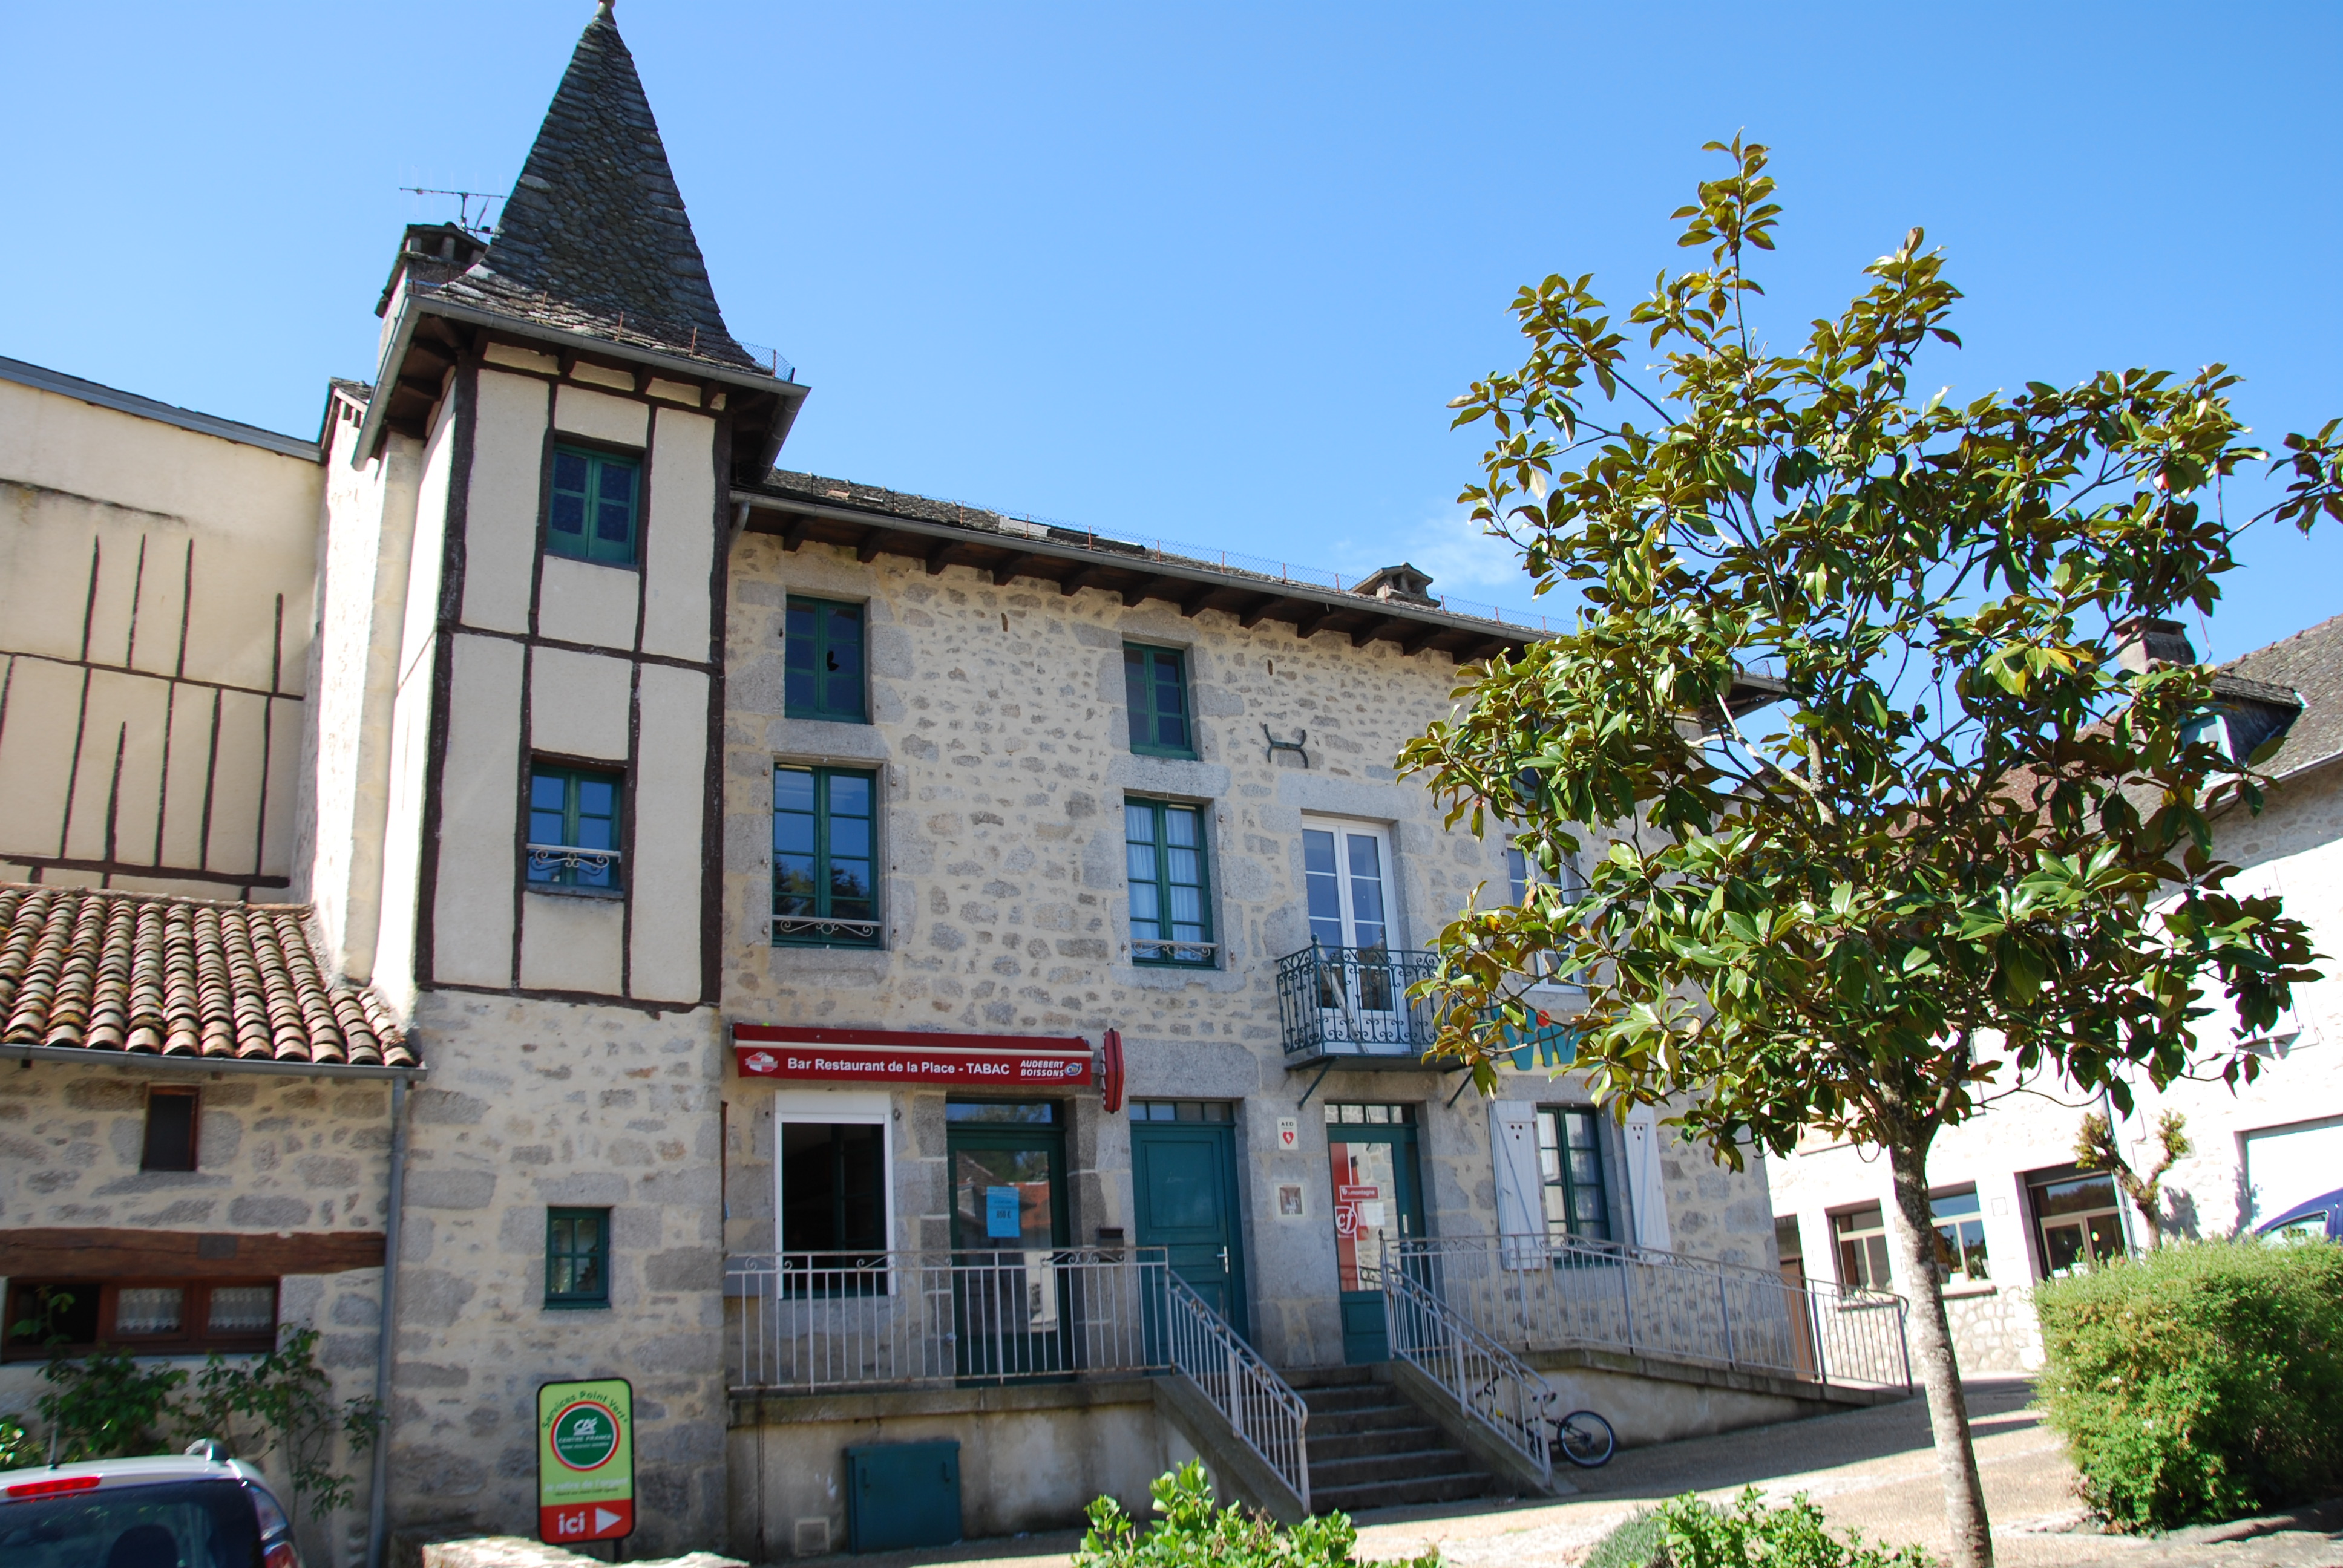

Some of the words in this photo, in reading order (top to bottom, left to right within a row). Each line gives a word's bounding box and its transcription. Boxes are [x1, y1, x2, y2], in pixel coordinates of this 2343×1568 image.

[1492, 1008, 1624, 1071] Viv
[787, 1057, 811, 1069] Bar
[814, 1058, 885, 1071] Restaurant
[887, 1060, 903, 1073] de
[907, 1062, 918, 1073] la
[921, 1062, 955, 1074] Place
[966, 1063, 1010, 1075] TABAC
[1020, 1060, 1064, 1069] AUDEBERT
[1020, 1068, 1064, 1077] BOISSONS
[542, 1394, 577, 1429] Services
[579, 1391, 608, 1402] Point
[558, 1435, 583, 1443] CENTRE
[585, 1433, 612, 1442] FRANCE
[558, 1511, 585, 1535] ici
